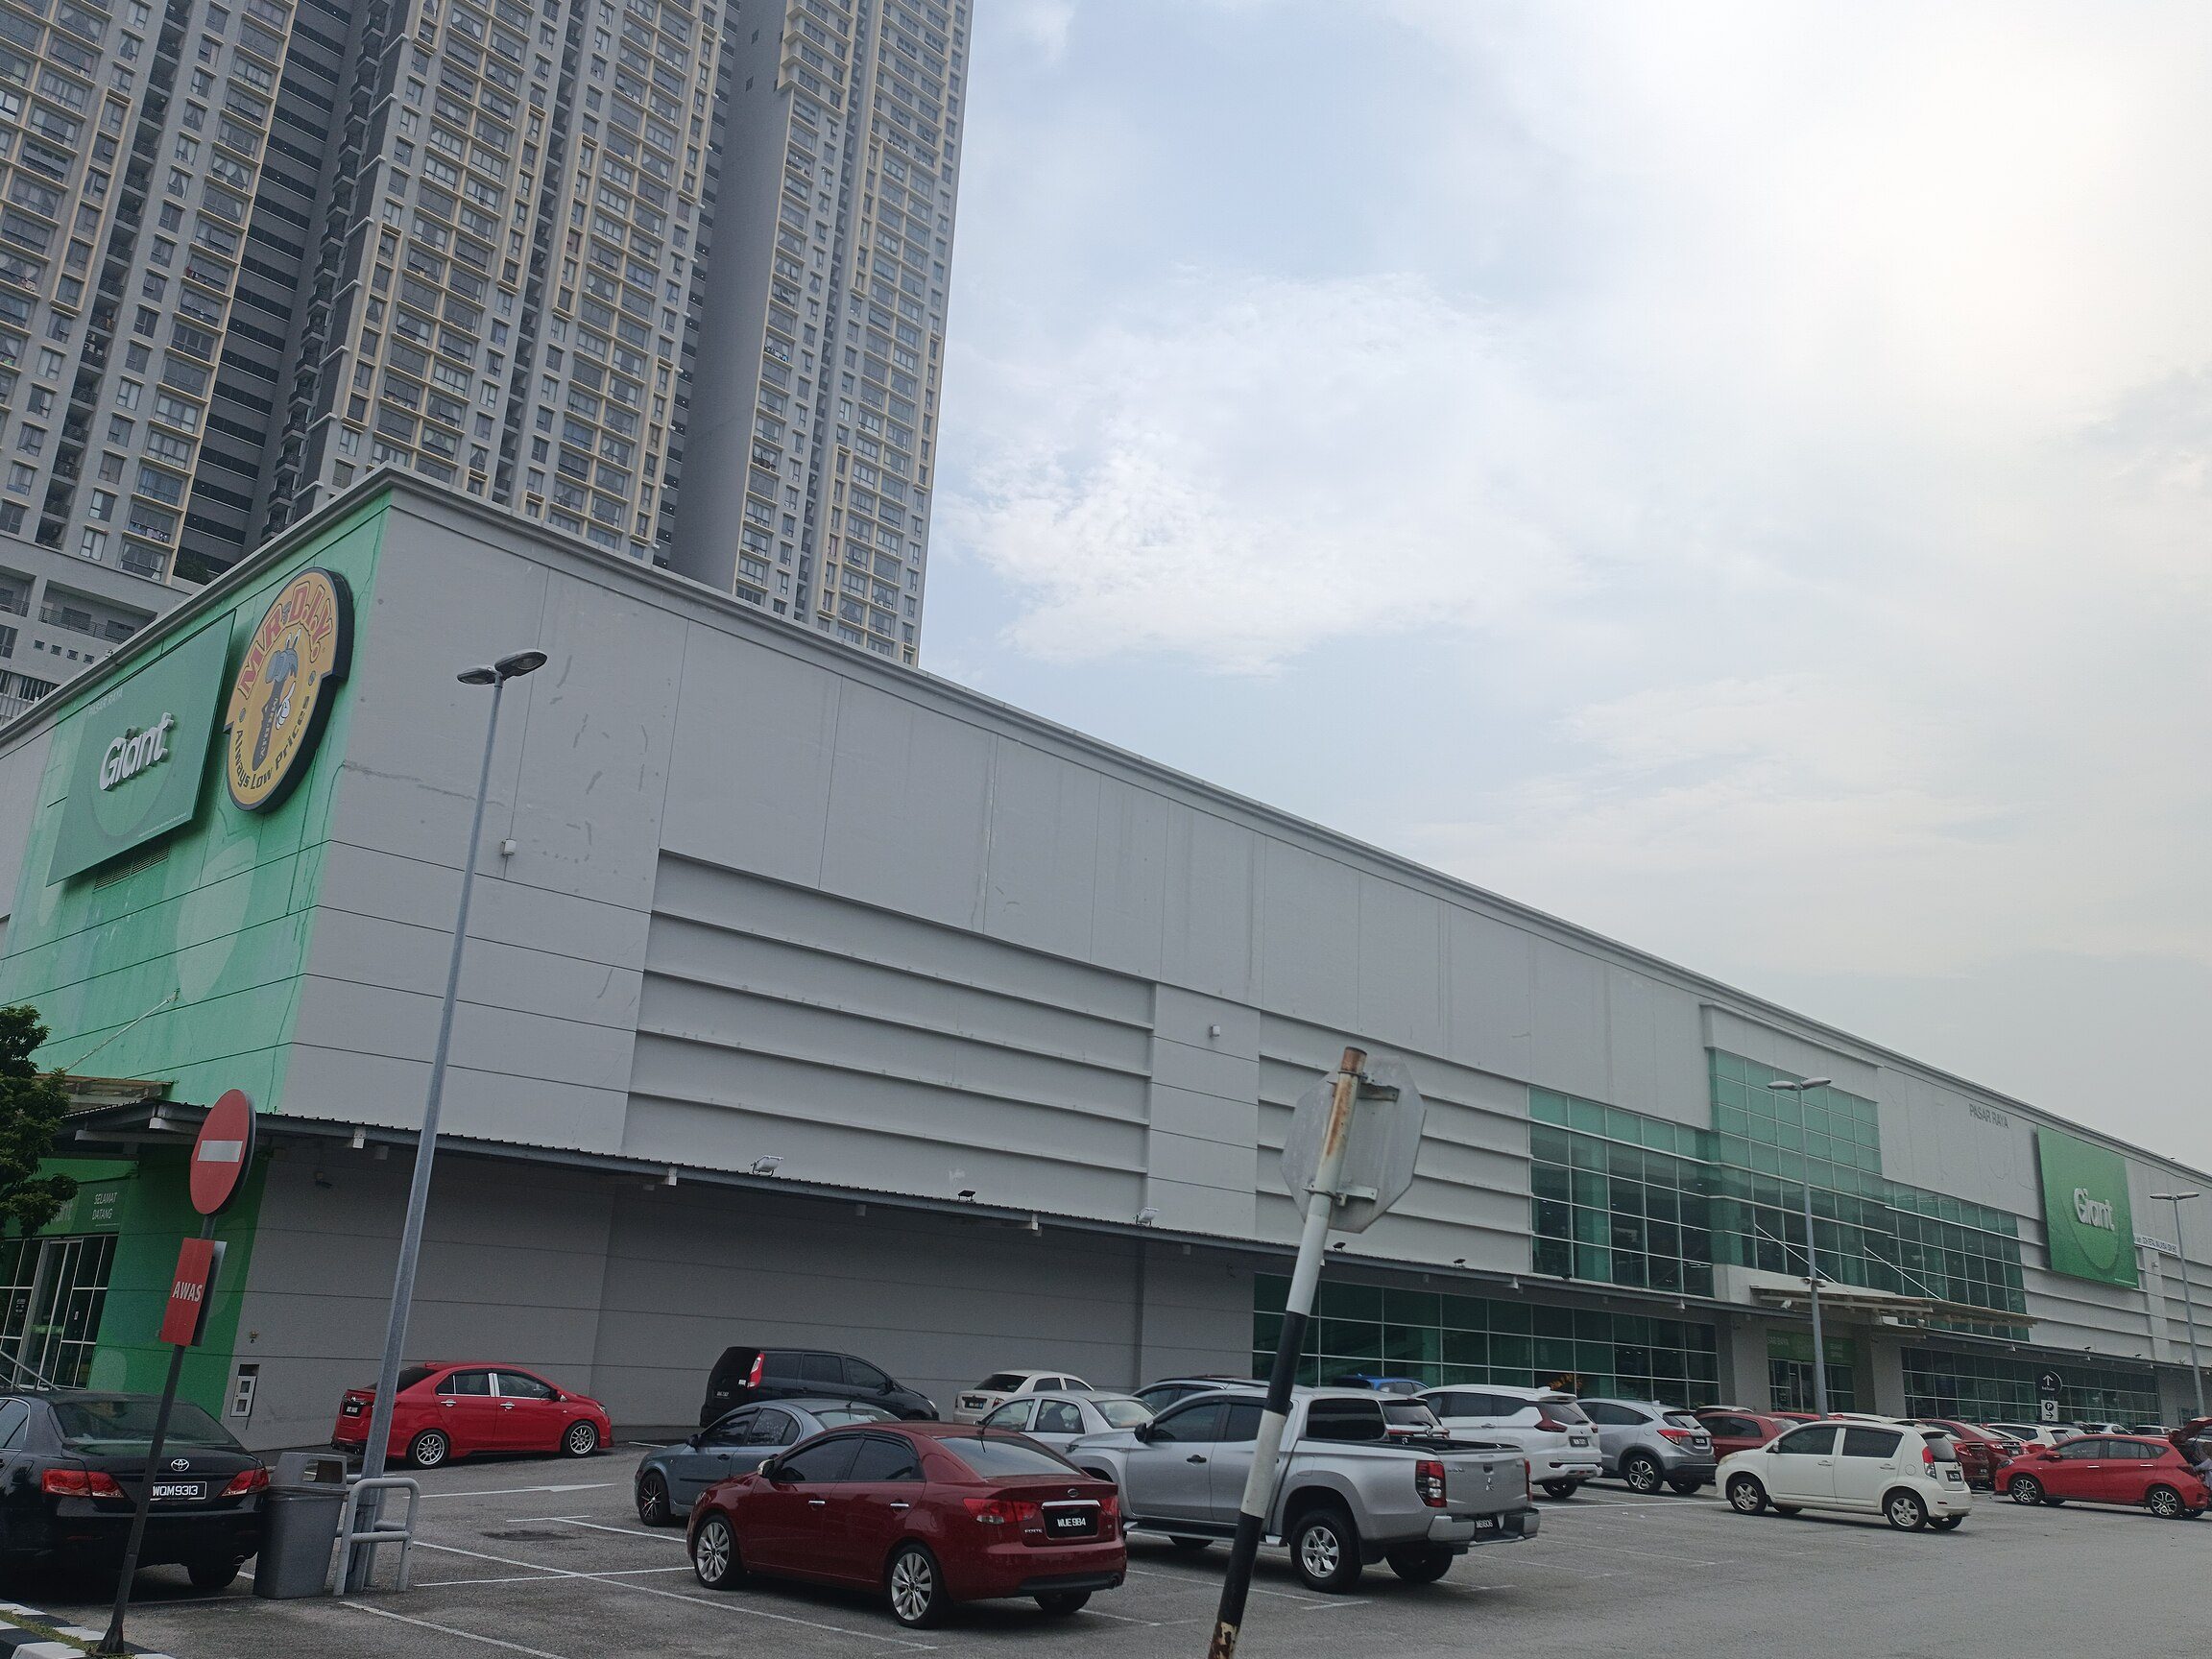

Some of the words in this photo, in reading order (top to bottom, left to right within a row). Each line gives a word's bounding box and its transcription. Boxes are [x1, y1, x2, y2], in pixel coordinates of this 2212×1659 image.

[99, 711, 175, 791] Giant
[234, 730, 251, 788] Always
[250, 766, 274, 790] Low
[1969, 1103, 1992, 1123] PASAR
[1991, 1111, 2009, 1129] RAYA
[93, 1191, 118, 1205] SELAMAT
[2074, 1188, 2115, 1231] Giant
[91, 1208, 113, 1220] DATANG
[172, 1281, 203, 1302] AWAS
[152, 1485, 199, 1497] WQM9313
